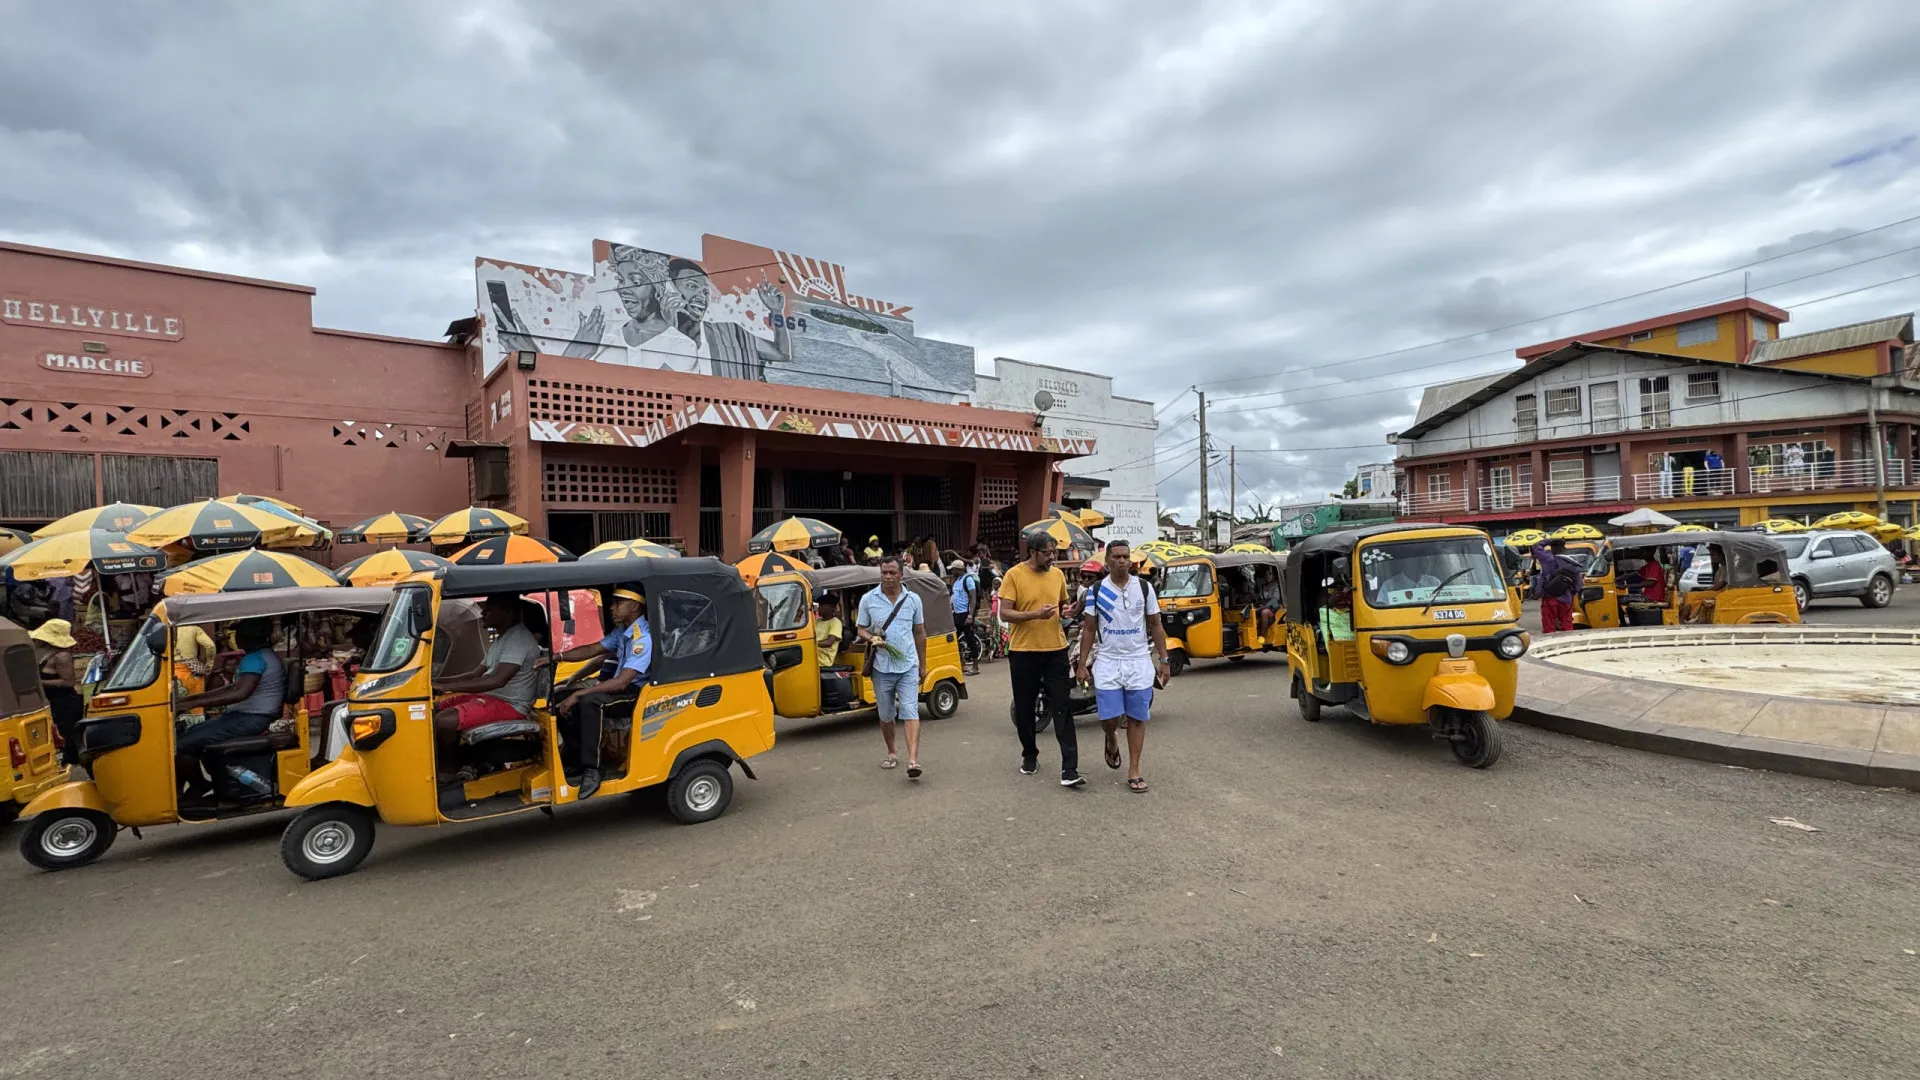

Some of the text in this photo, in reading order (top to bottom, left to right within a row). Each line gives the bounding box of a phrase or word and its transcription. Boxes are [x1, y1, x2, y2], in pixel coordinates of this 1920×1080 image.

[764, 313, 807, 332] 1964
[46, 353, 144, 374] MARCHE
[1109, 503, 1142, 518] Alliance
[1106, 525, 1144, 537] Française
[1103, 626, 1141, 635] Panasonic
